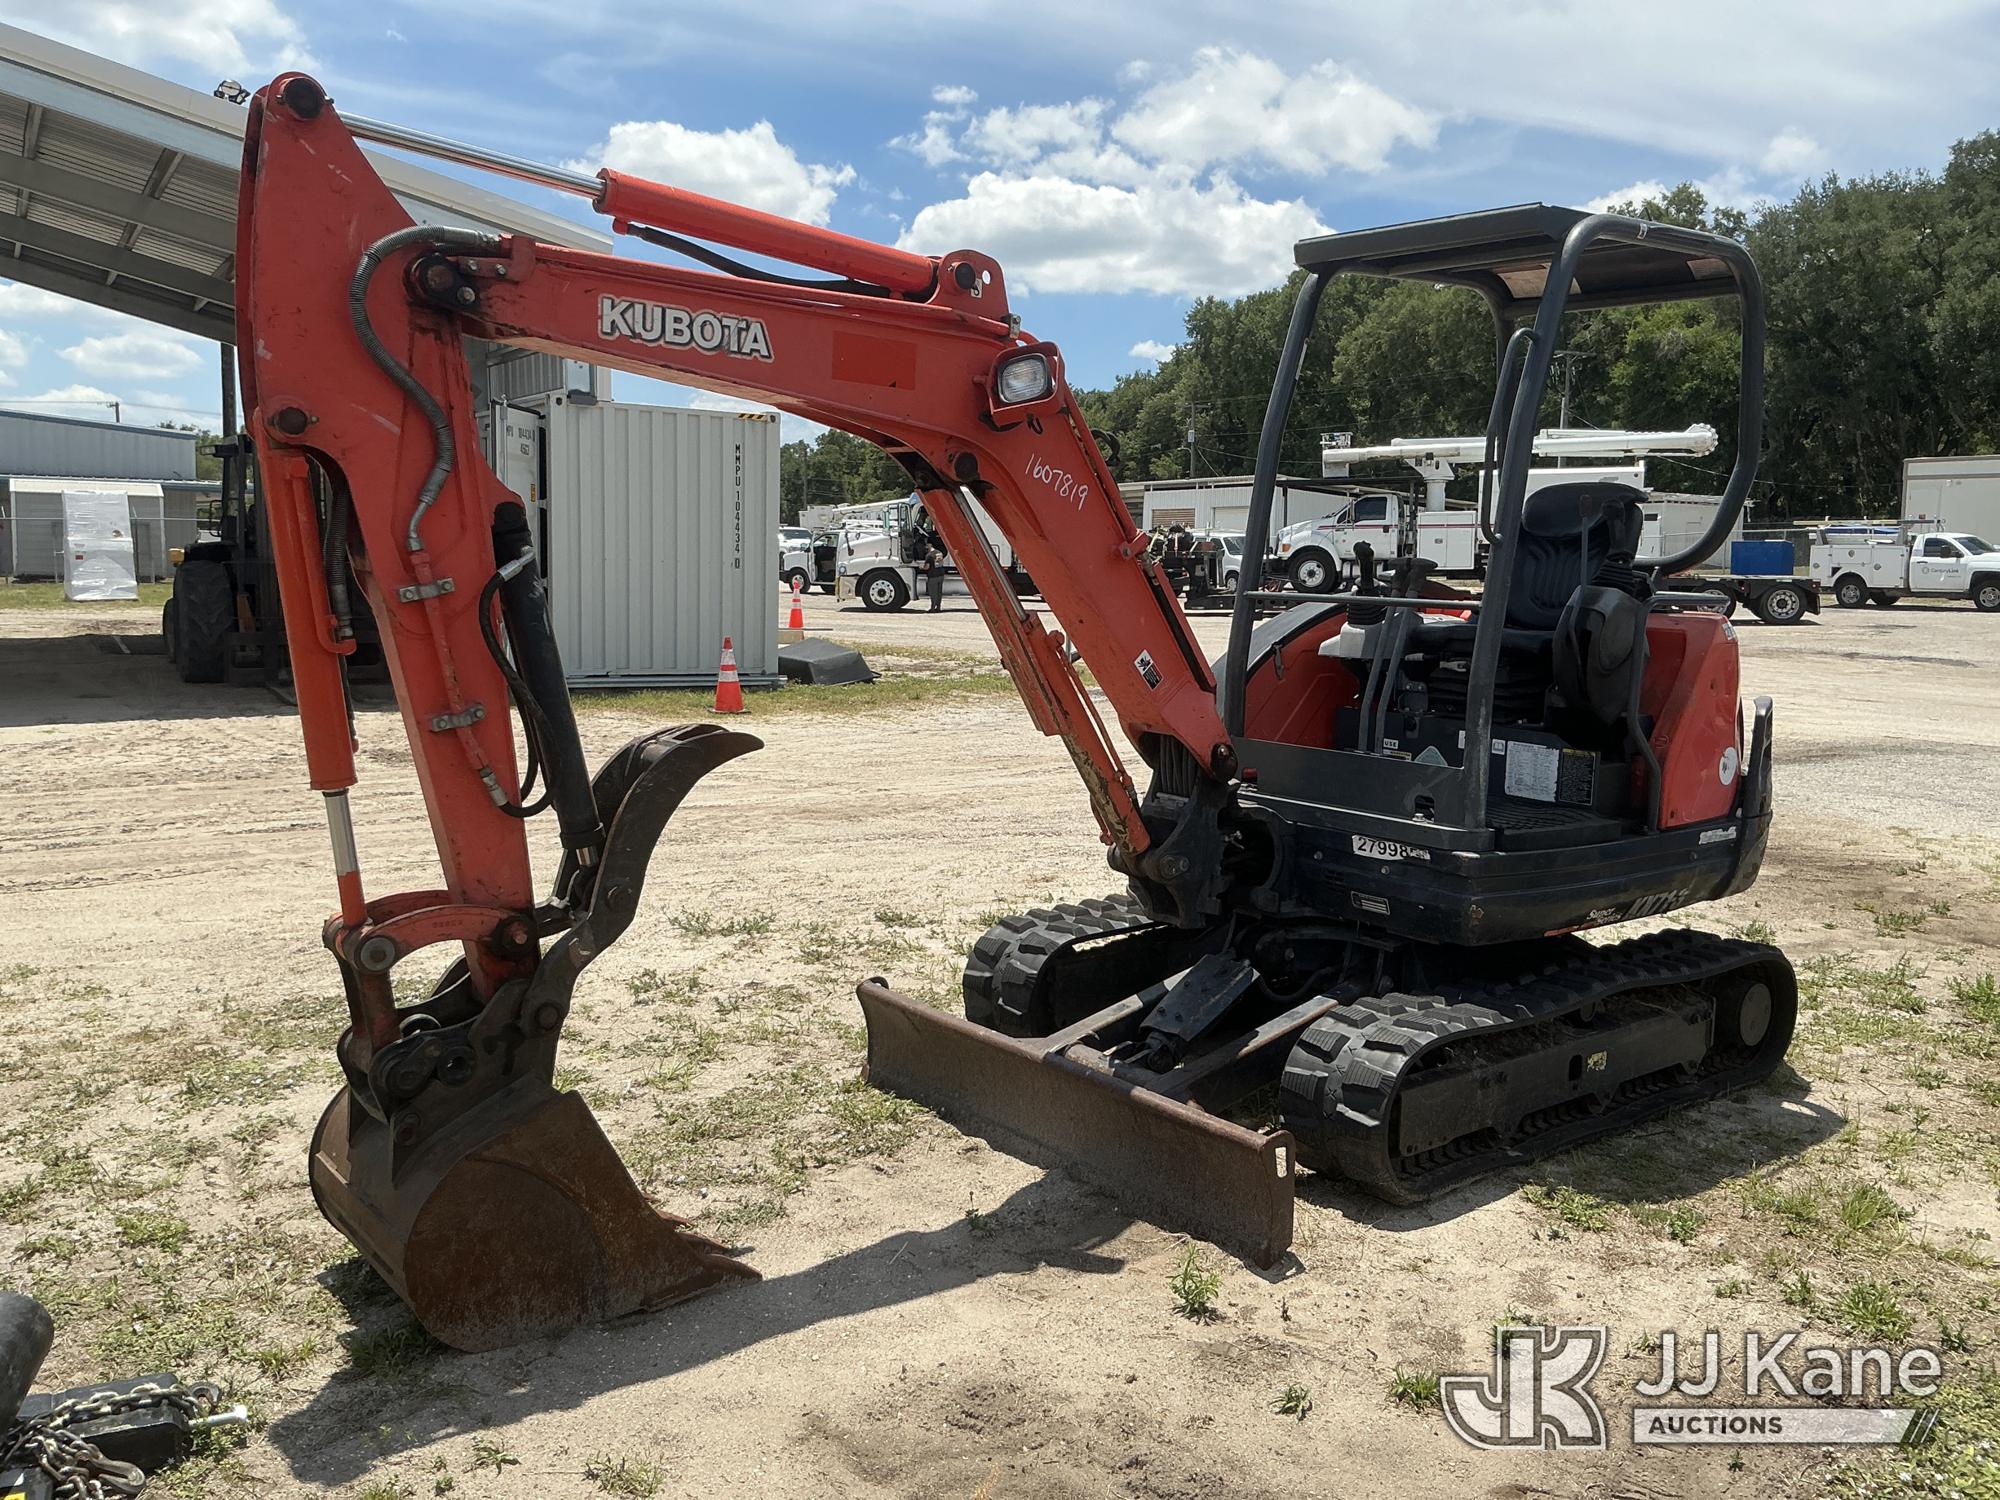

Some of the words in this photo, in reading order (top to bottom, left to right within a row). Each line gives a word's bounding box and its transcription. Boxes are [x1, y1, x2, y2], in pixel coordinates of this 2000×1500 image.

[600, 296, 771, 359] KUBOTA
[1025, 452, 1089, 511] 1607819
[1384, 740, 1397, 748] USE
[1357, 836, 1410, 858] 27998
